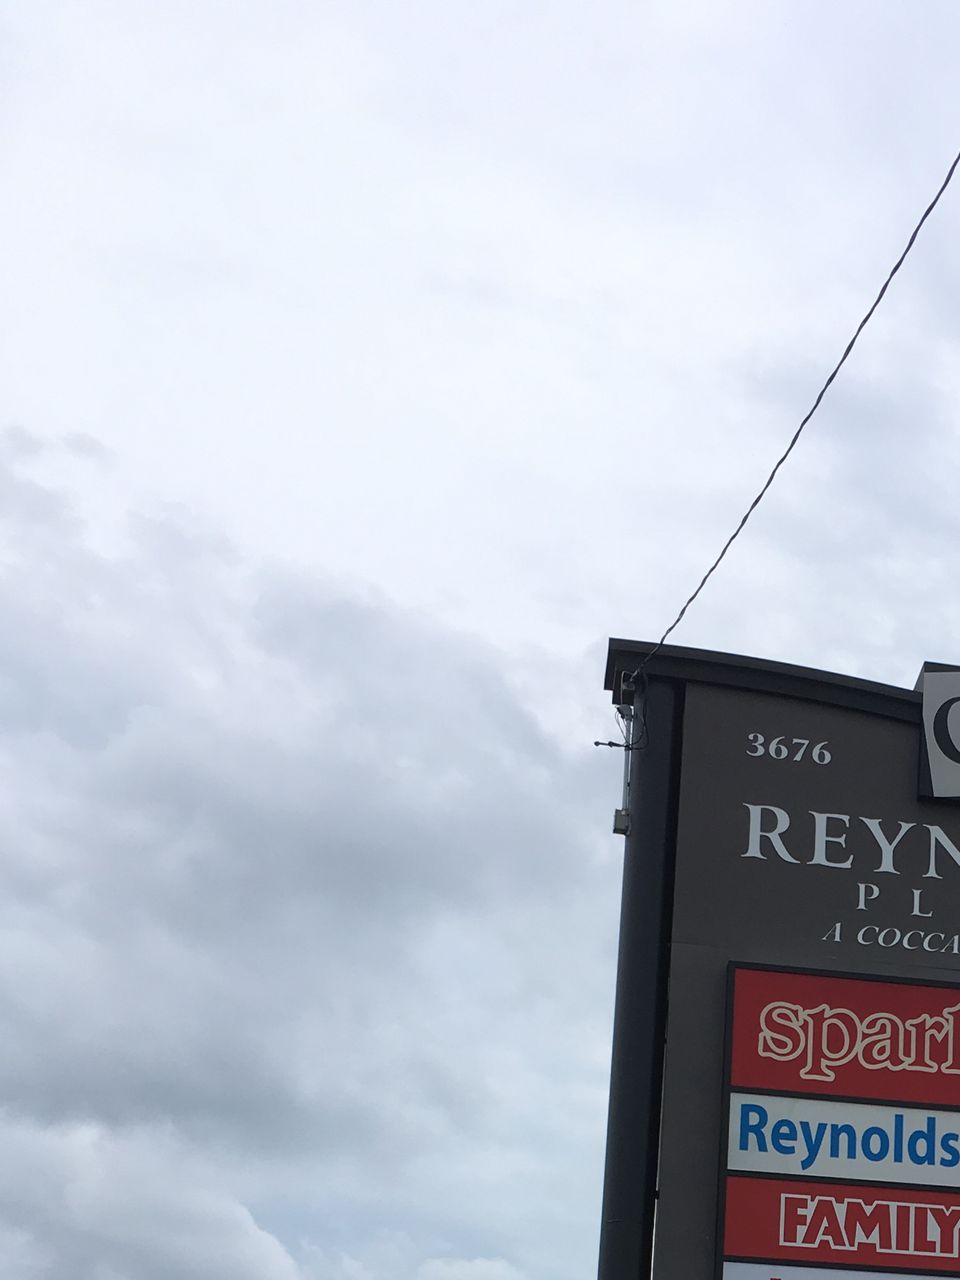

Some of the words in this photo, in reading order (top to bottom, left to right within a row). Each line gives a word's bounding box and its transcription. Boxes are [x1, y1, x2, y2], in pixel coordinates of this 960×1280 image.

[746, 733, 832, 766] 3676
[822, 922, 842, 943] A
[857, 926, 960, 955] COCCA
[738, 1103, 960, 1172] Reynolds
